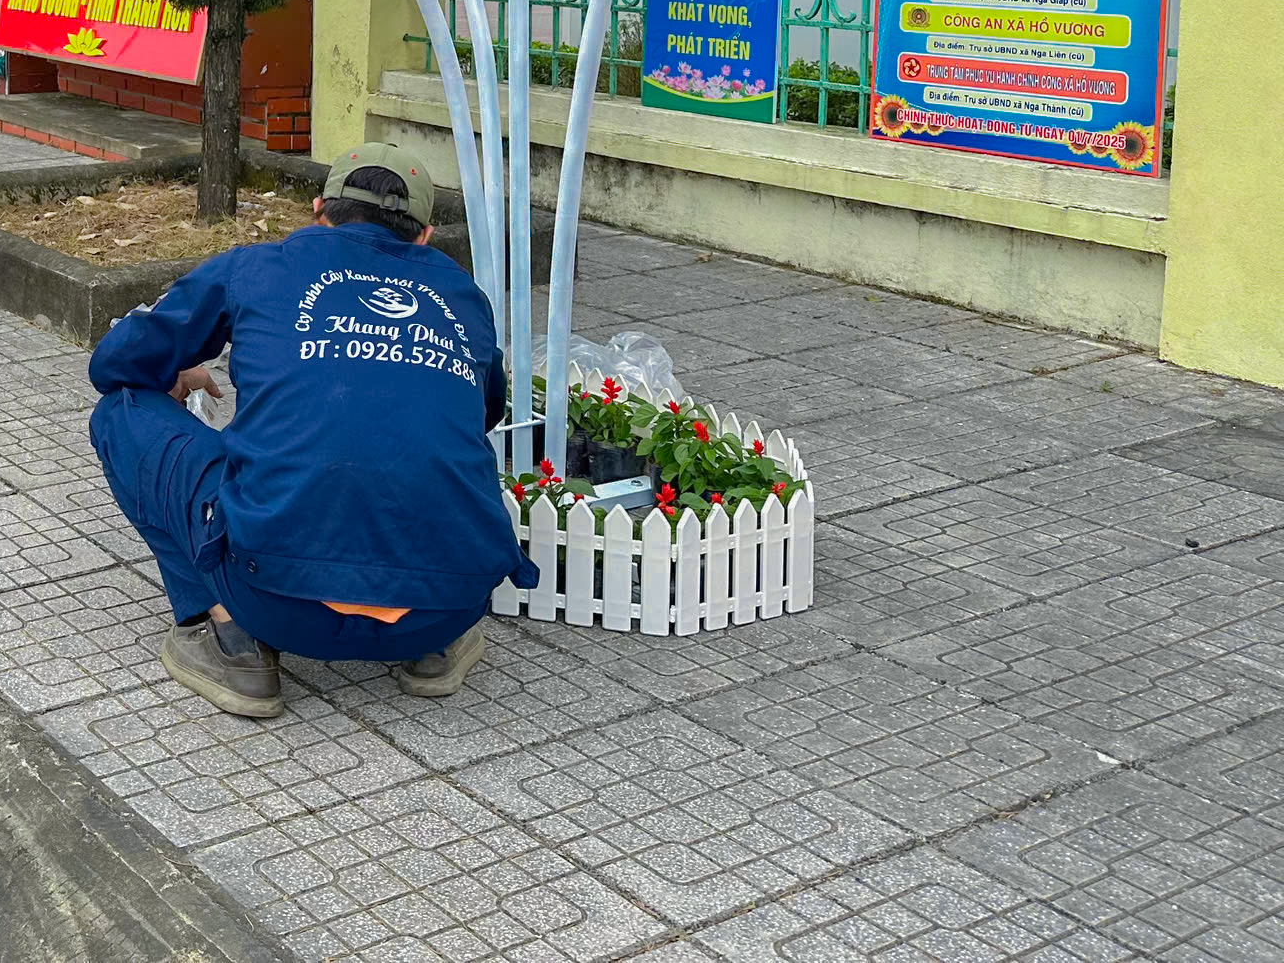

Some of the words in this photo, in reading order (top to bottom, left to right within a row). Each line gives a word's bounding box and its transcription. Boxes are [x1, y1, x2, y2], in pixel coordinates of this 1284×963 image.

[708, 3, 752, 29] VỌNG,
[944, 13, 981, 29] CÔNG
[984, 18, 1003, 30] AN
[1007, 16, 1025, 31] XÃ
[1029, 16, 1049, 33] HỒ
[1054, 21, 1105, 38] VƯƠNG
[667, 32, 704, 54] PHÁT
[707, 31, 751, 61] TRIỂN
[926, 64, 949, 79] TRUNG
[964, 95, 976, 105] Trụ
[988, 98, 1011, 108] UBND
[1013, 100, 1022, 109] xã
[1024, 102, 1040, 113] Nga
[1068, 106, 1084, 117] (cũ)
[957, 117, 984, 134] HOẠT
[987, 119, 1016, 136] ĐỘNG
[1035, 124, 1065, 141] NGÀY
[1068, 129, 1126, 149] 01/7/2025
[320, 269, 344, 285] Cây
[345, 268, 381, 282] Xanh
[324, 315, 402, 341] Khang
[407, 323, 456, 353] Phát
[346, 339, 477, 387] 0926.527.888
